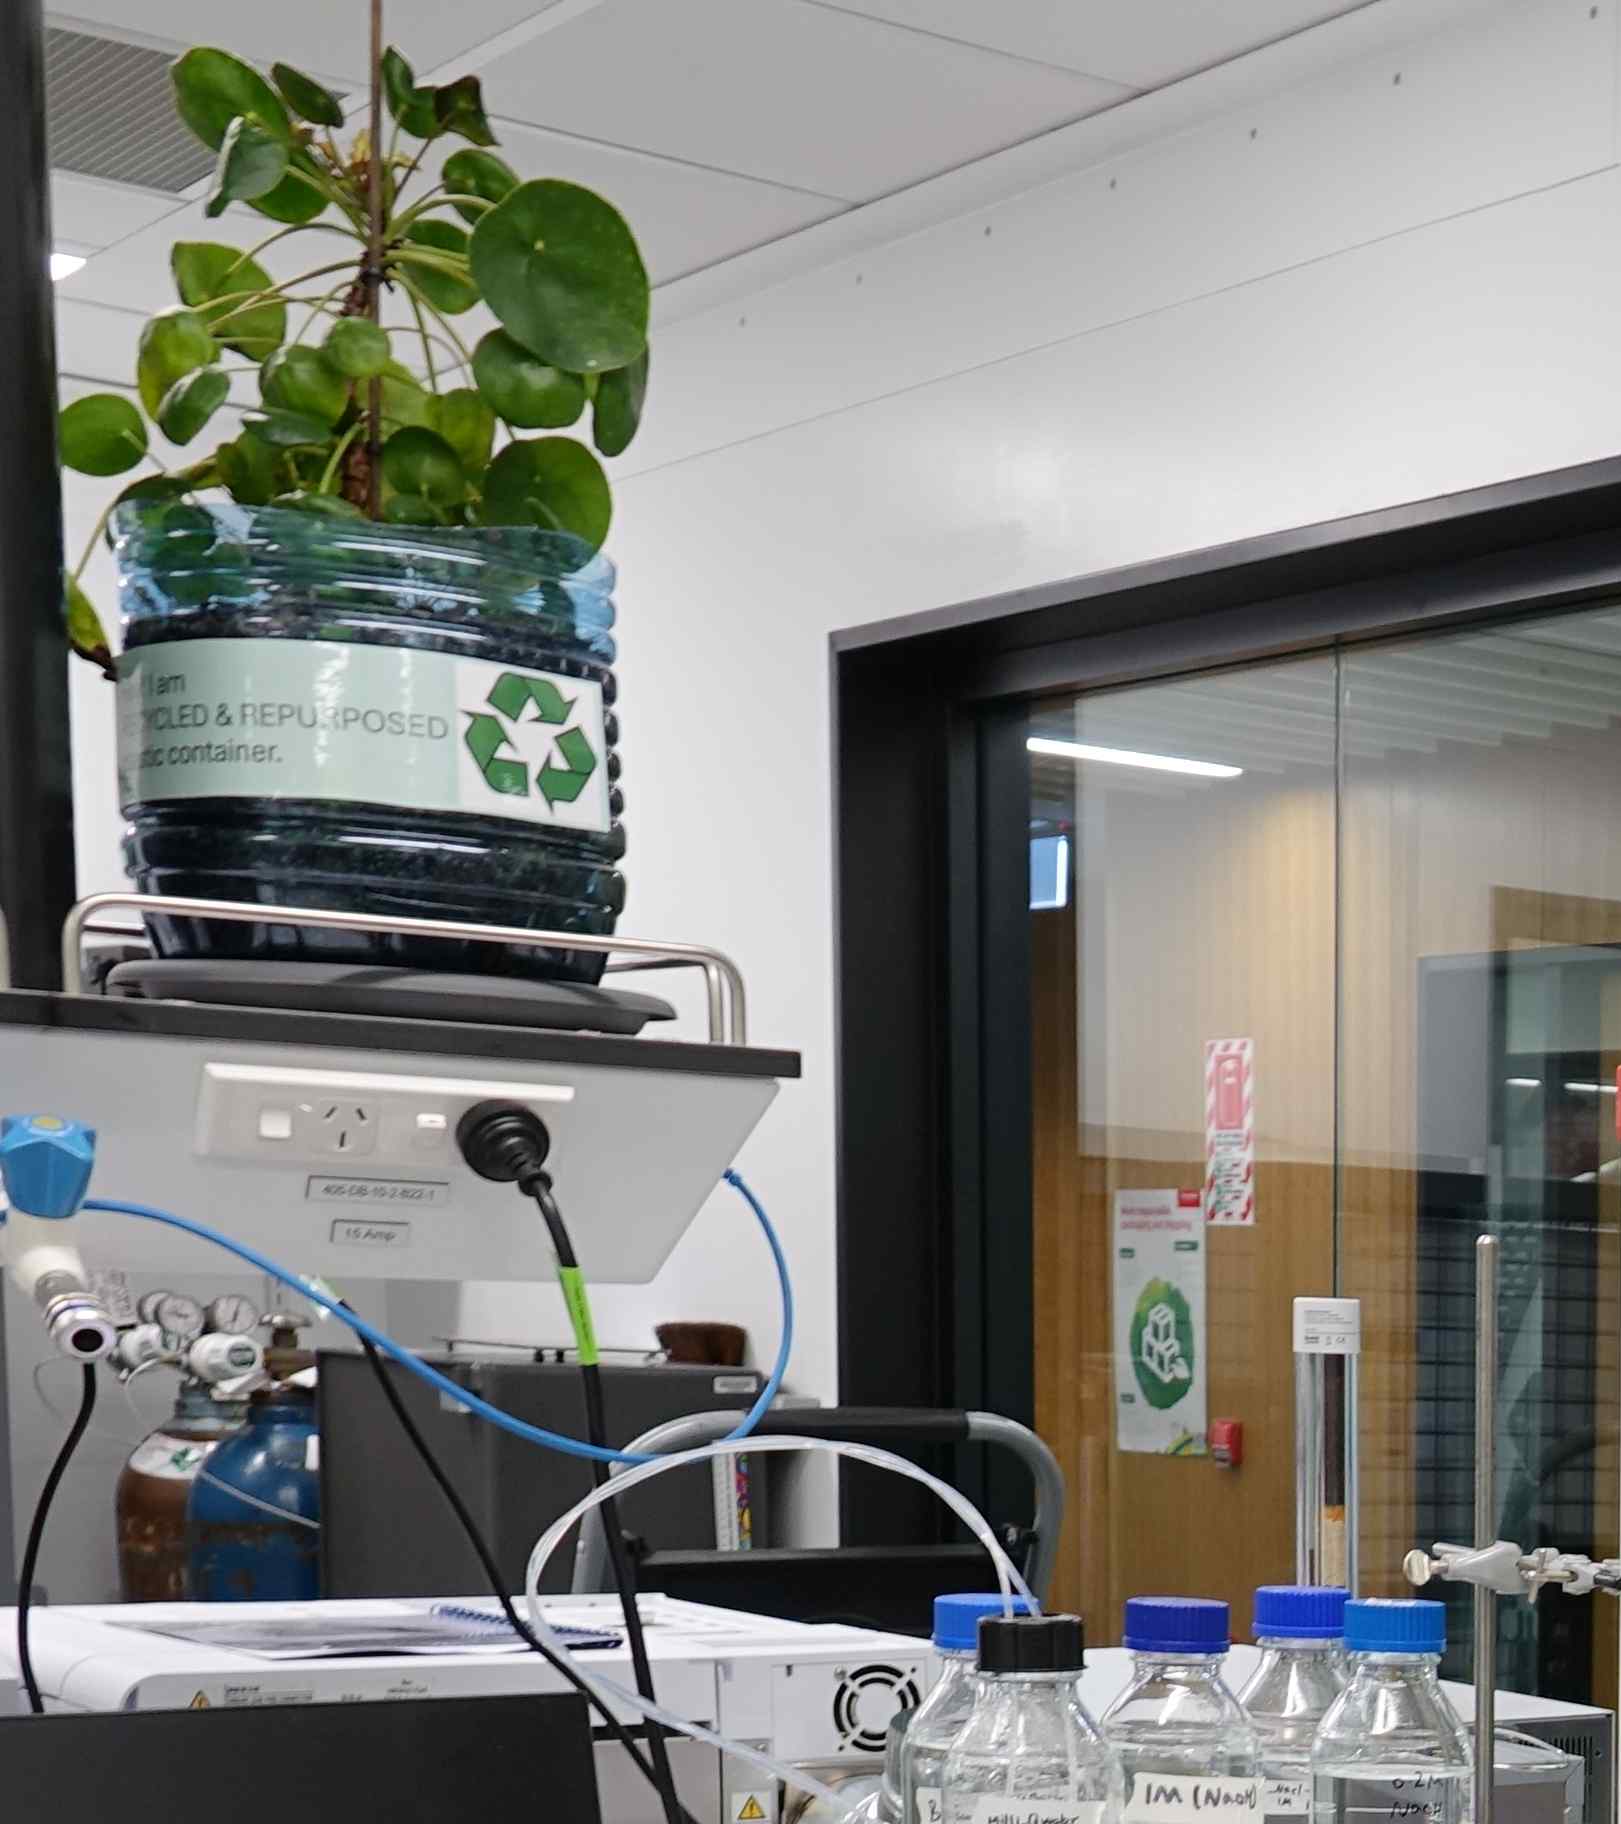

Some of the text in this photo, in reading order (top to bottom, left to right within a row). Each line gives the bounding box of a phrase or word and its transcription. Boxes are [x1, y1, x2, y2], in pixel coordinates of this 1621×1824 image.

[214, 703, 232, 726] &
[240, 703, 448, 740] REPURPOSED
[167, 738, 284, 766] container.
